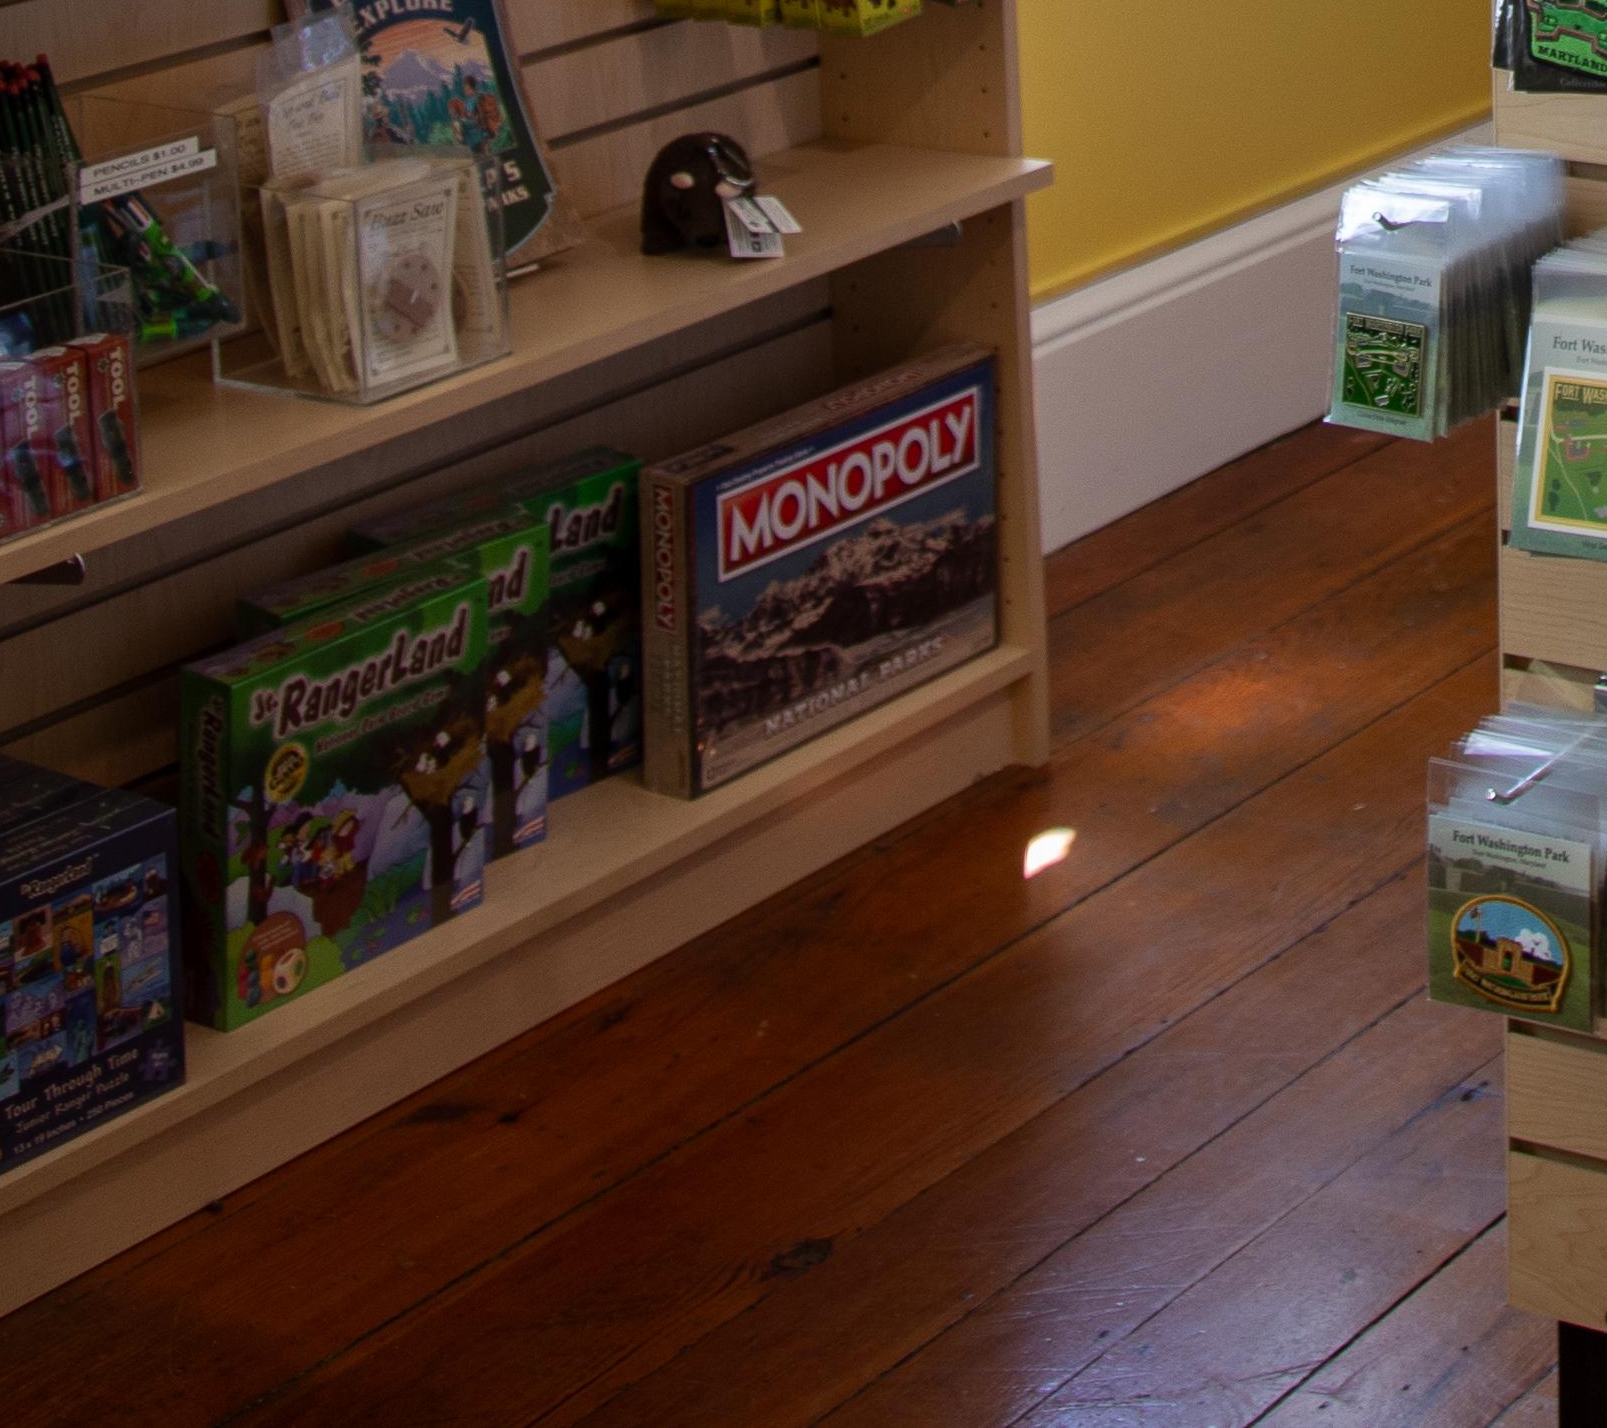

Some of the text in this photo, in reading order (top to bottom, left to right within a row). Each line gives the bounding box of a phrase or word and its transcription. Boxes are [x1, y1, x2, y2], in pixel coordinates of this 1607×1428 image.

[94, 143, 187, 177] PENCILS $1.00
[169, 156, 205, 175] $4.99
[367, 198, 446, 232] Buzz Saw
[1552, 335, 1580, 351] Fort
[109, 345, 124, 411] TOOL
[1554, 382, 1583, 401] FORT
[23, 375, 43, 441] TOOL
[729, 403, 972, 563] MONOPOLY
[278, 606, 470, 737] RangerLand
[764, 634, 943, 735] NATIONAL PARKS
[1452, 829, 1571, 865] Fort Washington Park
[4, 1046, 140, 1120] Tour Through Time
